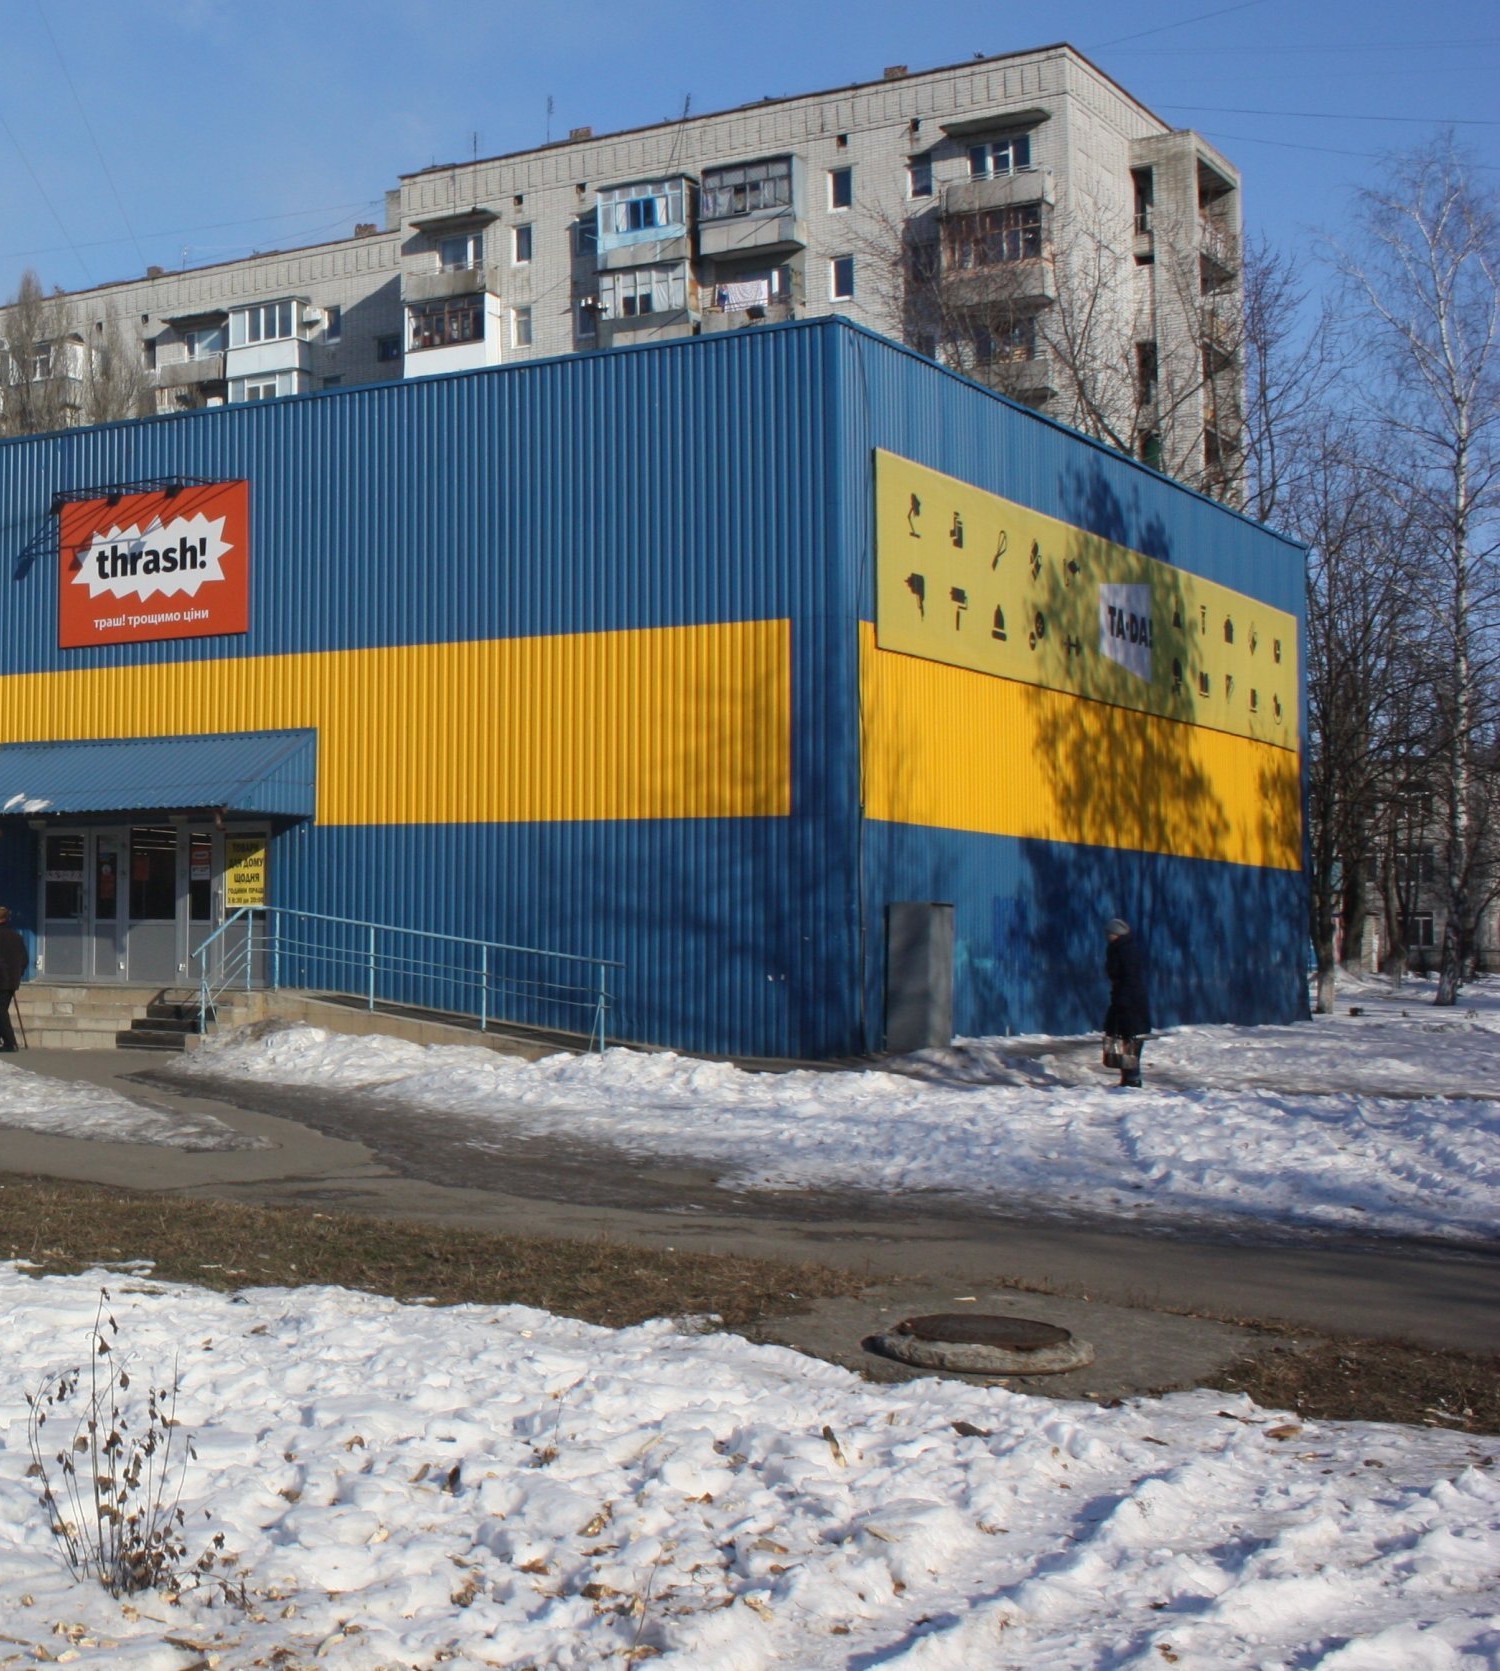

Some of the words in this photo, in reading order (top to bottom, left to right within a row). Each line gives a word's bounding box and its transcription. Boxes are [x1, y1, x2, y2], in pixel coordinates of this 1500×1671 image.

[96, 536, 208, 580] thrash!
[94, 614, 126, 631] траш!
[127, 611, 181, 628] трощимо
[183, 607, 209, 623] ціни
[243, 857, 264, 869] ДОМУ
[233, 873, 260, 884] ЩОДНЯ
